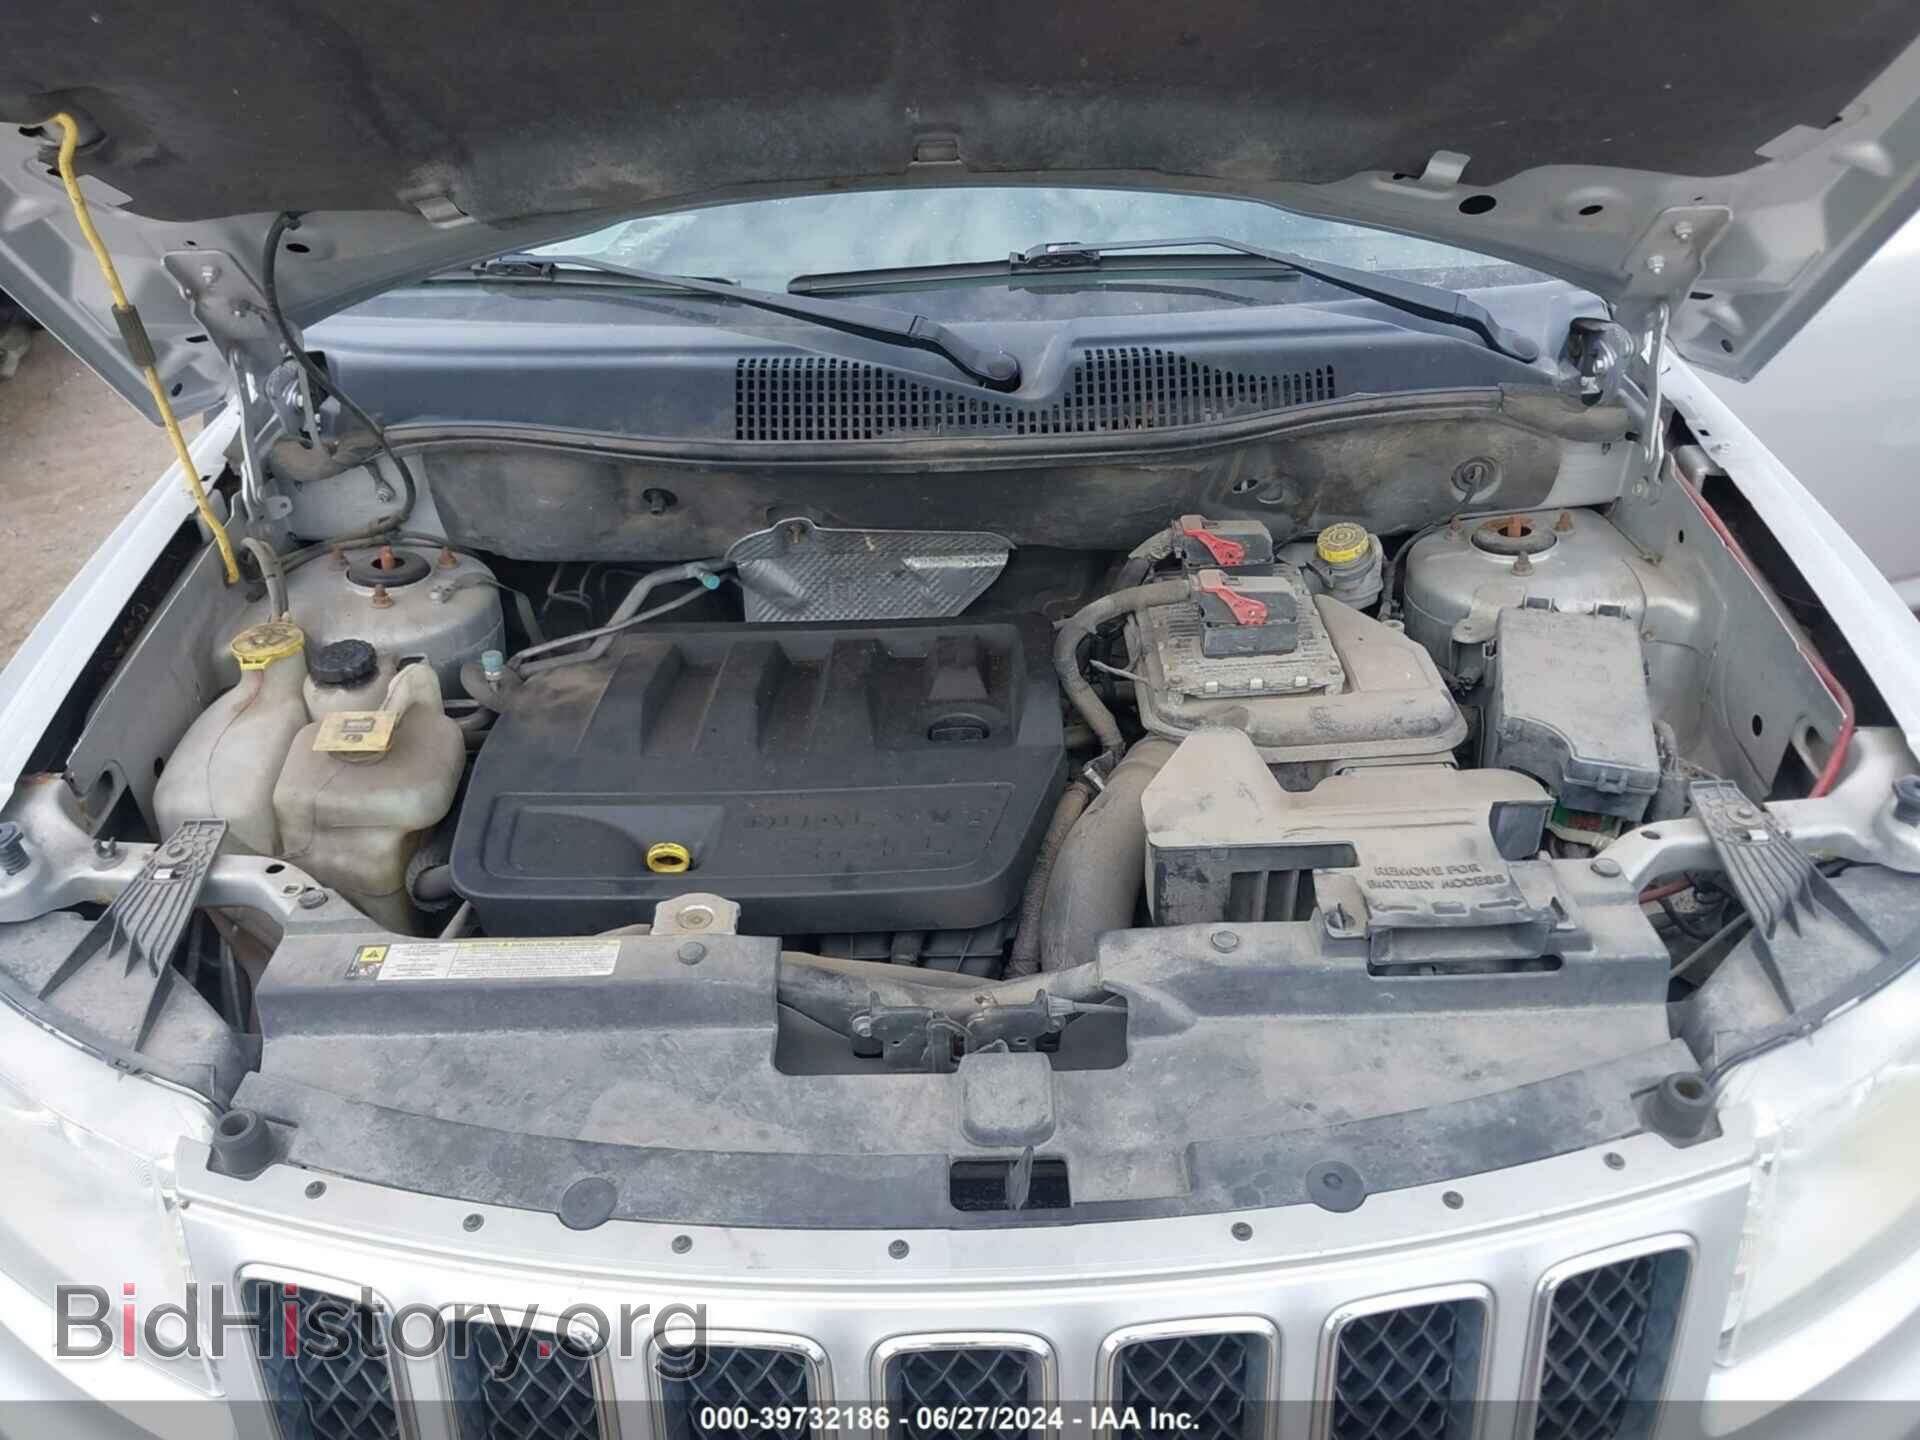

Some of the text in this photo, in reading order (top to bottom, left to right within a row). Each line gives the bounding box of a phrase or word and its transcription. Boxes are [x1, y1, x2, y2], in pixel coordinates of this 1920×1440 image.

[1374, 863, 1481, 876] REMOVE FOR
[1367, 875, 1505, 889] BATTERY ACCESS
